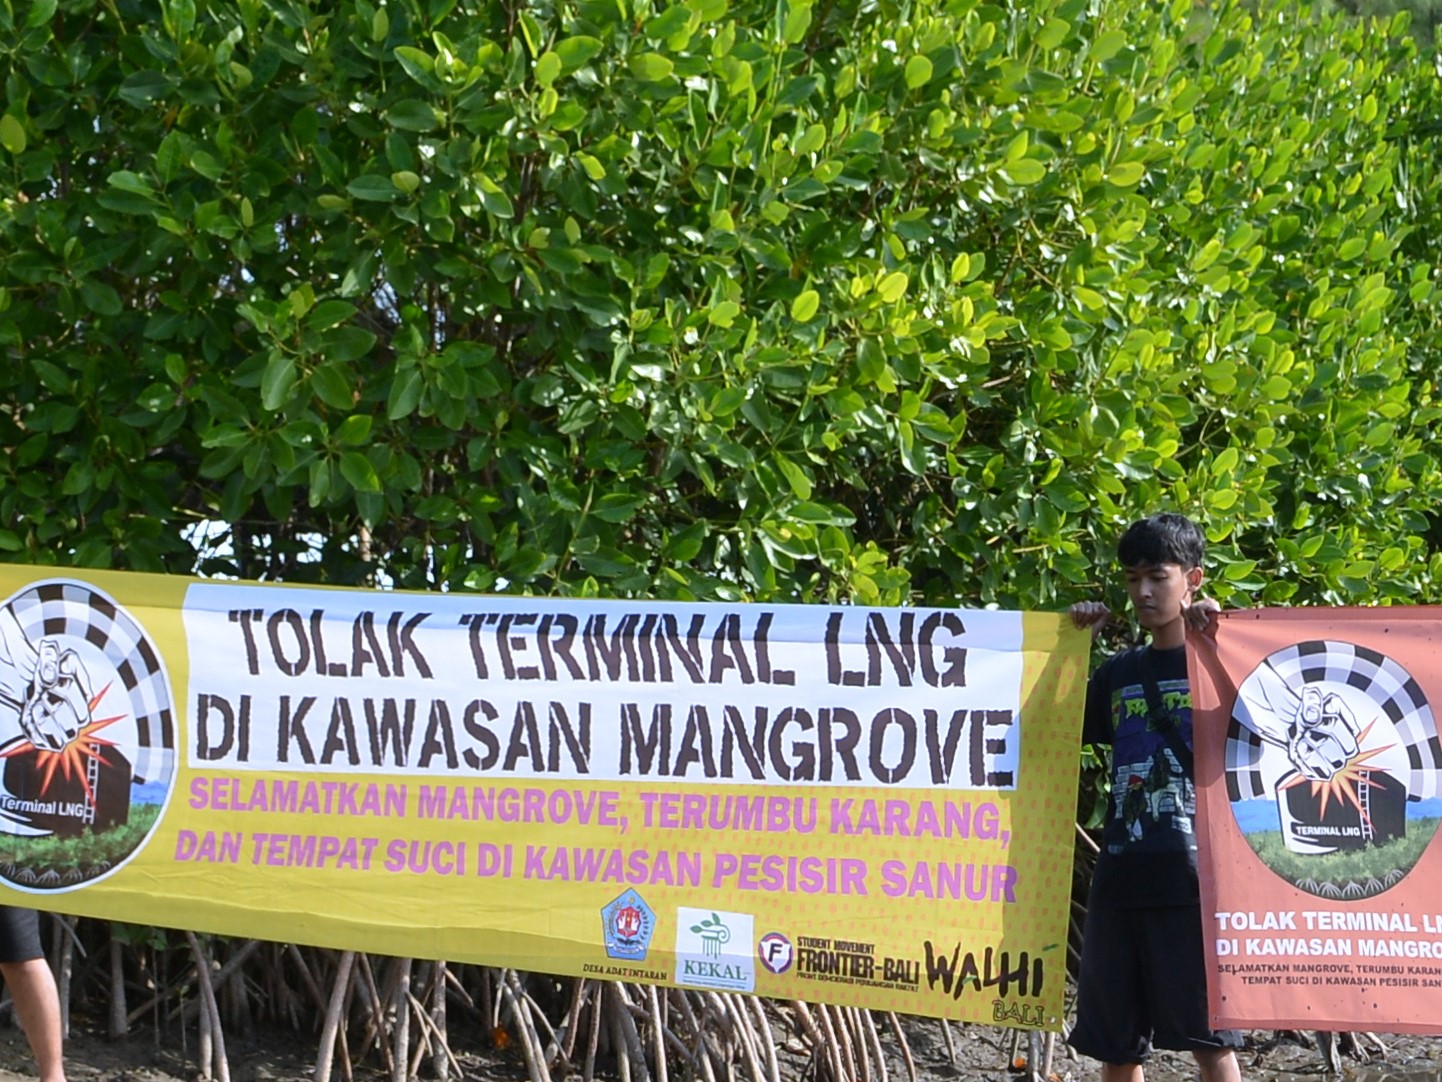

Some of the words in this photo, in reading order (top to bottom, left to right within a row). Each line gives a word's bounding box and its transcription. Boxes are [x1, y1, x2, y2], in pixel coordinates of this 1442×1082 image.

[229, 609, 433, 680] TOLAK
[457, 611, 796, 687] TERMINAL
[824, 611, 967, 688] LNG
[196, 693, 250, 762] DI
[277, 696, 591, 774] KAWASAN
[619, 702, 1014, 787] MANGROVE
[1, 796, 56, 814] Terminal
[59, 802, 84, 817] LNG
[189, 777, 413, 821] SELAMATKAN
[417, 785, 628, 835] MANGROVE,
[640, 792, 818, 834] TERUMBU
[829, 797, 1011, 847] KARANG,
[1295, 826, 1340, 836] TERMINAL
[1341, 826, 1361, 837] LNG
[175, 829, 243, 864] DAN
[252, 833, 378, 871] TEMPAT
[384, 838, 465, 876] SUCI
[478, 842, 513, 878] DI
[523, 844, 701, 888] KAWASAN
[712, 852, 868, 896] PESISIR
[880, 861, 1018, 904] SANUR
[1215, 911, 1296, 931] TOLAK
[1302, 911, 1418, 933] TERMINAL
[797, 936, 831, 950] STUDENT
[834, 940, 876, 955] MOVEMENT
[1215, 938, 1238, 957] DI
[1245, 938, 1351, 957] KAWASAN
[583, 963, 604, 973] DESA
[606, 966, 626, 977] ADAT
[684, 959, 748, 981] KEKAL
[797, 948, 920, 985] FRONTIER-BALI
[924, 940, 1043, 1001] WALHI
[1218, 963, 1290, 974] SELAMATKAN
[1292, 964, 1353, 975] MANGROVE,
[1355, 964, 1405, 975] TERUMBU
[1241, 976, 1281, 986] TEMPAT
[1286, 976, 1309, 986] SUCI
[1312, 976, 1323, 986] DI
[1325, 977, 1376, 987] KAWASAN
[1379, 977, 1420, 988] PESISIR
[992, 999, 1045, 1027] BALI
